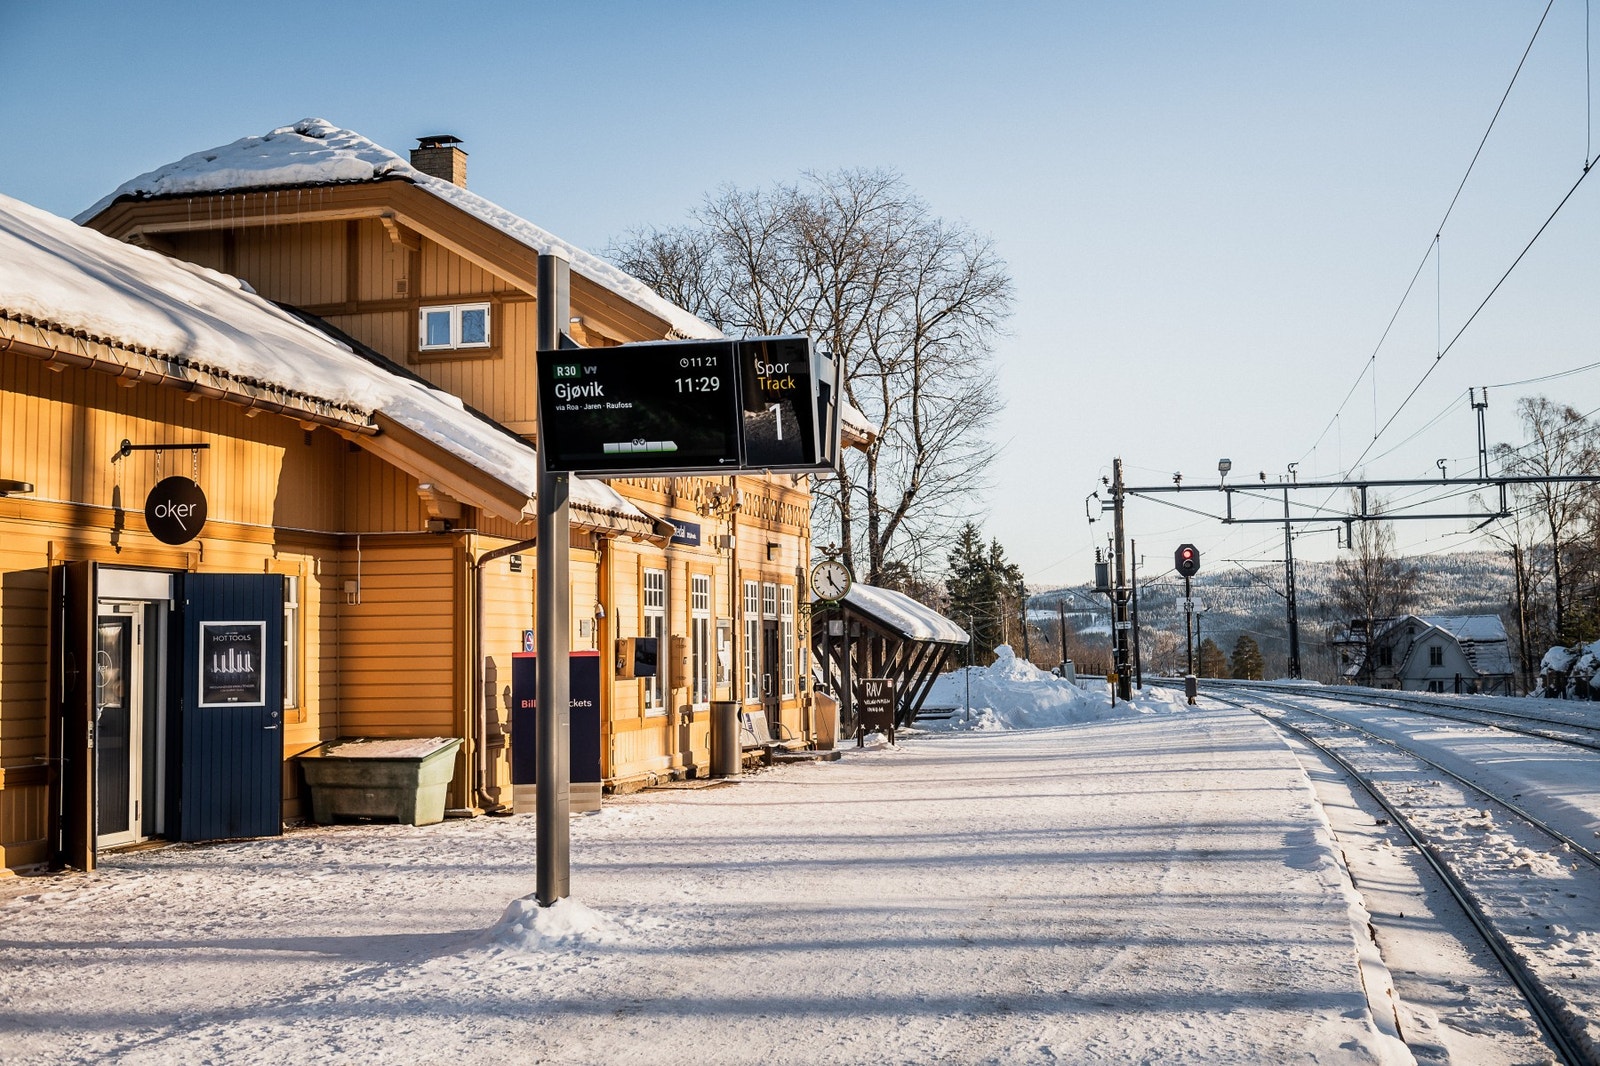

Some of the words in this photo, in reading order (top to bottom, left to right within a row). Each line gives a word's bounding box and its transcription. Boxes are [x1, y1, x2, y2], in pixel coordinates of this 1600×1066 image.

[691, 357, 701, 367] 11
[705, 356, 717, 367] 21
[757, 361, 790, 378] Spor
[556, 366, 577, 377] R30
[555, 381, 604, 401] Gjøvik
[675, 377, 720, 393] 11:29
[758, 376, 795, 390] Track
[566, 403, 579, 411] Roa
[606, 401, 633, 409] Raufoss
[769, 403, 783, 441] 1
[155, 500, 197, 531] oker
[866, 681, 883, 697] RAV
[569, 699, 592, 707] ckets
